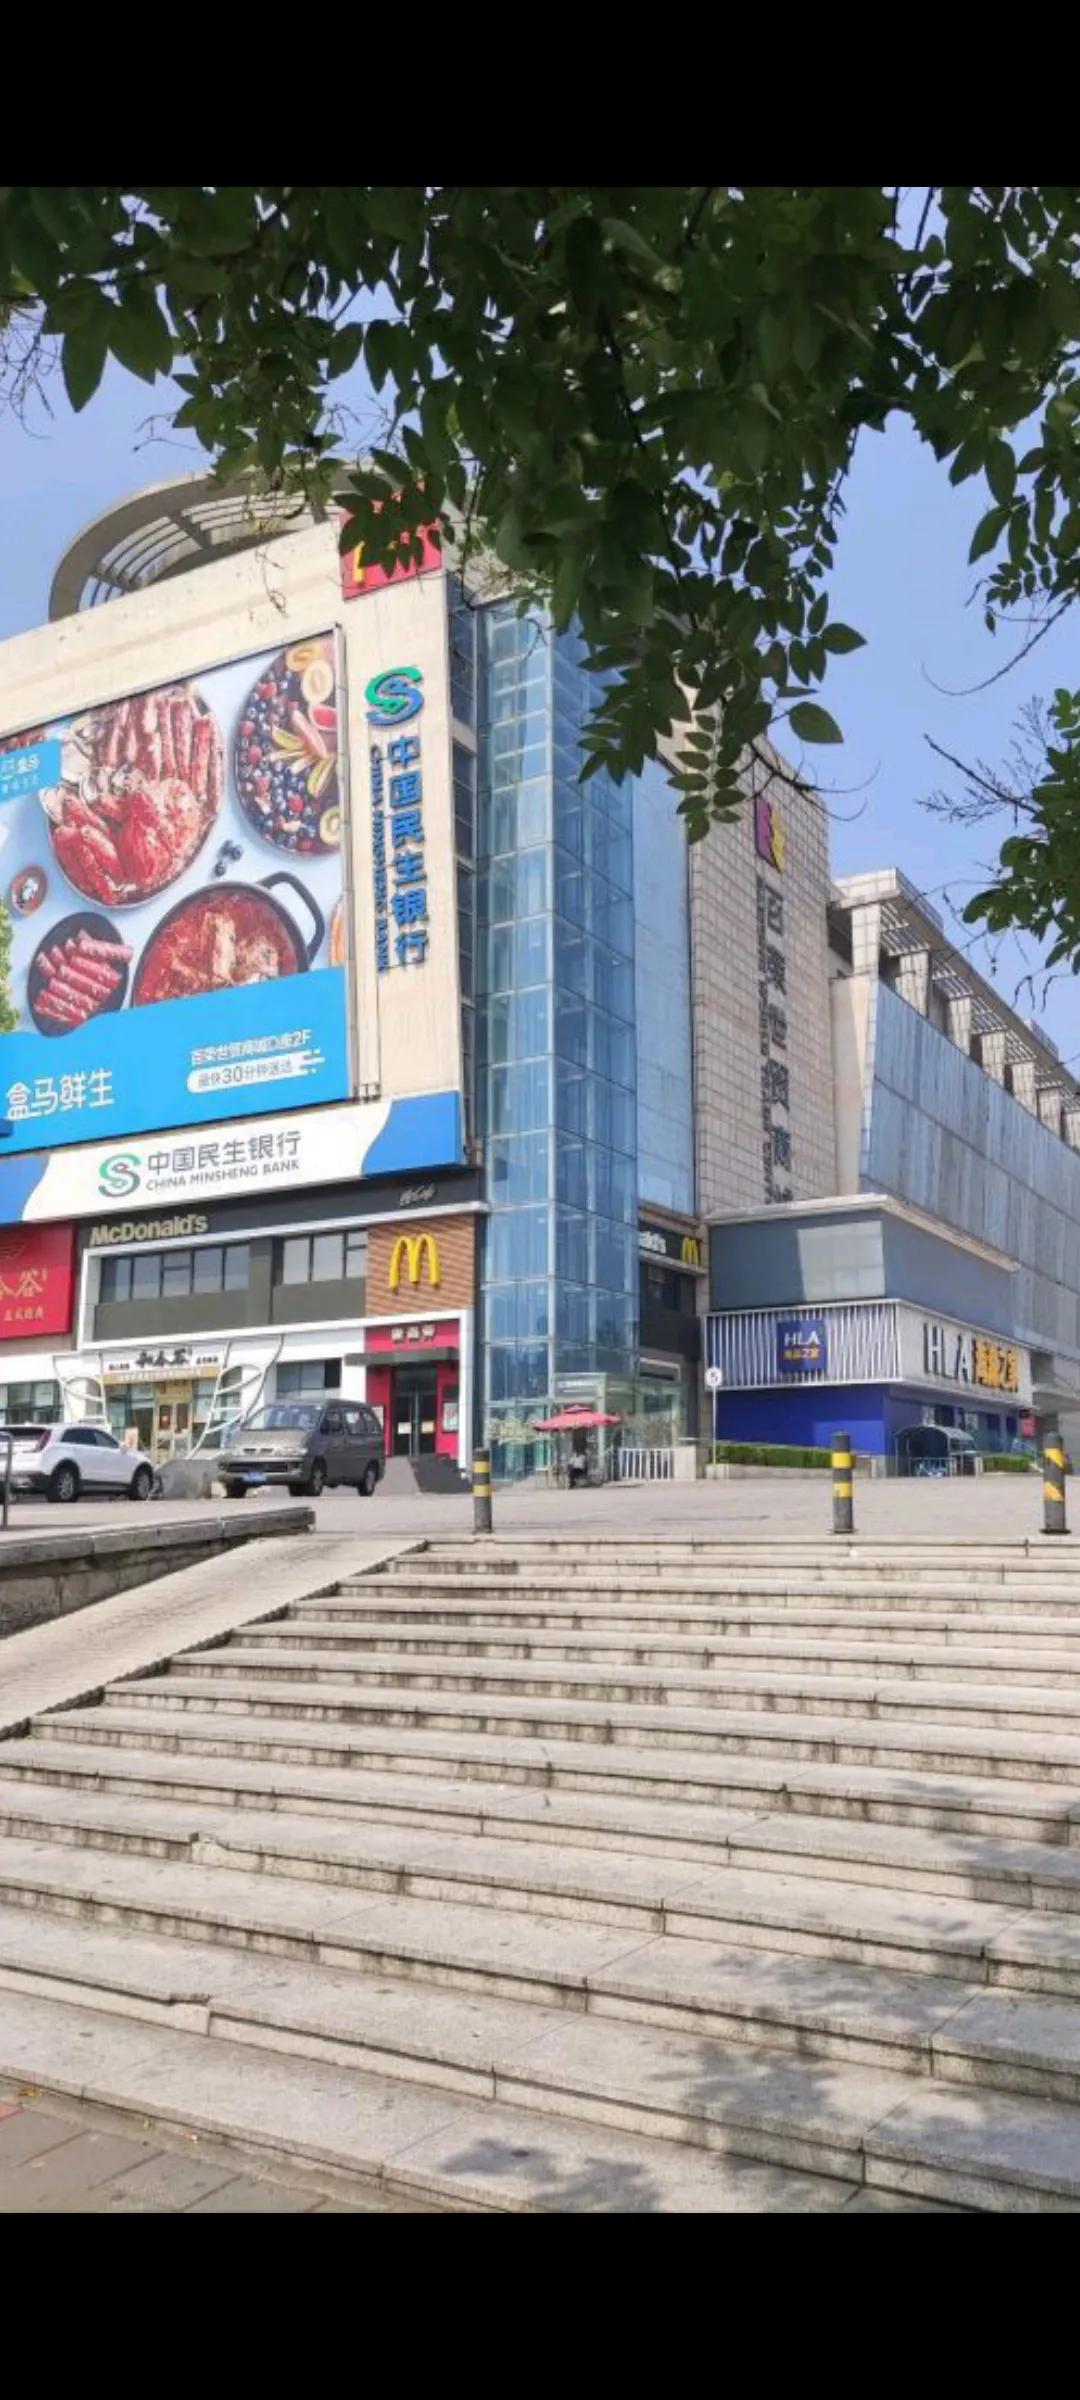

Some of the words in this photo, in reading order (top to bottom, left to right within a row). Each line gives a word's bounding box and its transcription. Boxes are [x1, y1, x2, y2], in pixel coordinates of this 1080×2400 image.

[387, 735, 428, 968] 中国民生银行
[5, 1068, 115, 1120] 盒马鲜生
[147, 1130, 301, 1175] 中国民生银行
[146, 1176, 186, 1192] CHINA
[189, 1165, 258, 1184] MINSHENG
[262, 1159, 300, 1176] BANK
[89, 1213, 208, 1248] McDonald's
[784, 1331, 820, 1347] HLA
[923, 1322, 972, 1388] HLA
[972, 1333, 1018, 1392] 海澜之家
